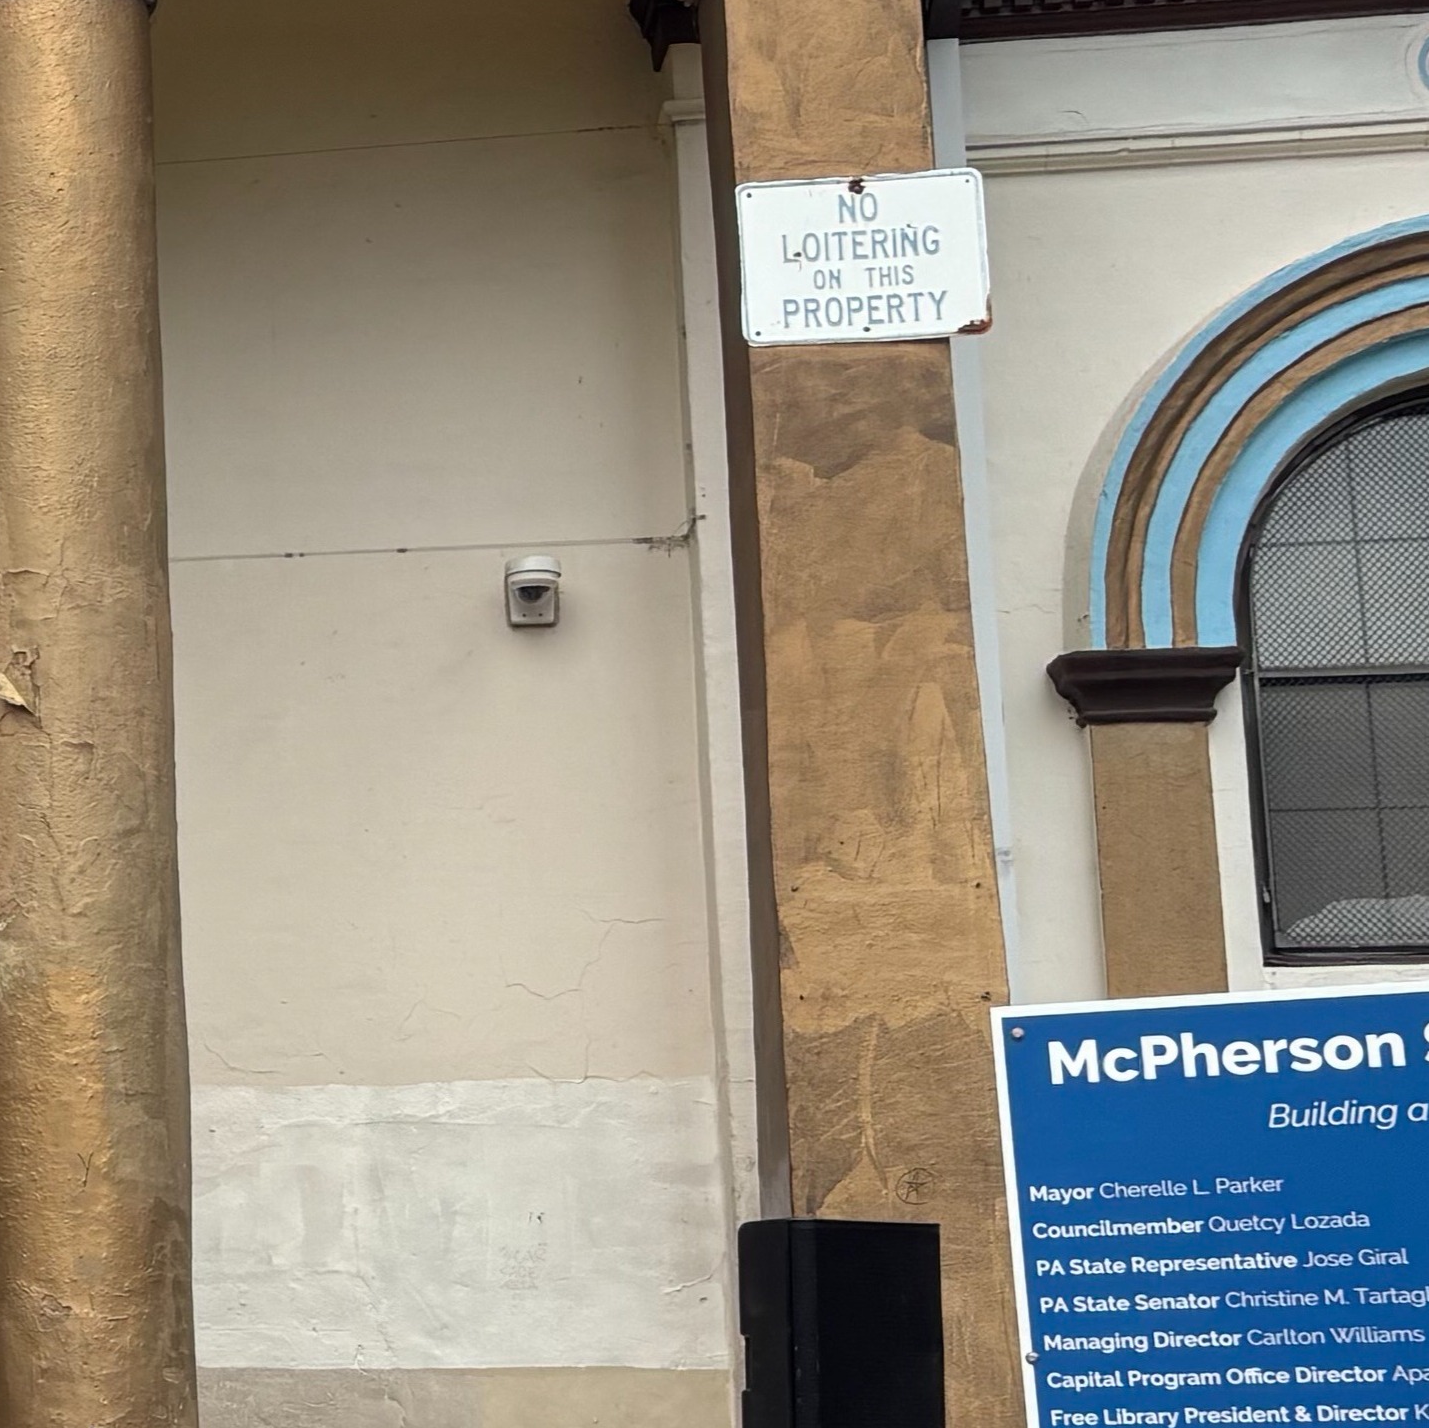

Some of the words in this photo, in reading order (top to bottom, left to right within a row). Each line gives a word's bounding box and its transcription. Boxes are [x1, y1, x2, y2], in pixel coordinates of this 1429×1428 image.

[837, 192, 878, 224] NO
[782, 225, 941, 264] LOITERING
[813, 268, 842, 290] ON
[865, 264, 914, 288] THIS
[782, 290, 948, 329] PROPERTY
[1047, 1031, 1406, 1085] McPherson
[1268, 1099, 1399, 1130] Building
[1029, 1185, 1095, 1205] Mayor
[1099, 1180, 1188, 1199] Cherelle
[1215, 1176, 1284, 1194] Parker
[1032, 1217, 1204, 1239] Councilmember
[1208, 1215, 1286, 1235] Quetcy
[1291, 1211, 1371, 1229] Lozada
[1036, 1259, 1066, 1276] PA
[1069, 1258, 1127, 1275] State
[1130, 1252, 1298, 1277] Representative
[1303, 1251, 1354, 1268] Jose
[1358, 1248, 1409, 1266] Giral
[1039, 1297, 1070, 1314] PA
[1072, 1295, 1131, 1313] State
[1134, 1293, 1221, 1311] Senator
[1225, 1290, 1320, 1308] Christine
[1043, 1332, 1149, 1355] Managing
[1152, 1330, 1242, 1349] Director
[1247, 1328, 1326, 1346] Carlton
[1329, 1326, 1426, 1345] Williams
[1046, 1370, 1124, 1392] Capital
[1127, 1370, 1222, 1391] Program
[1225, 1367, 1291, 1385] Office
[1294, 1366, 1388, 1384] Director
[1050, 1409, 1099, 1426] Free
[1103, 1408, 1180, 1428] Library
[1184, 1406, 1291, 1424] President
[1295, 1405, 1312, 1422] &
[1316, 1404, 1409, 1422] Director
